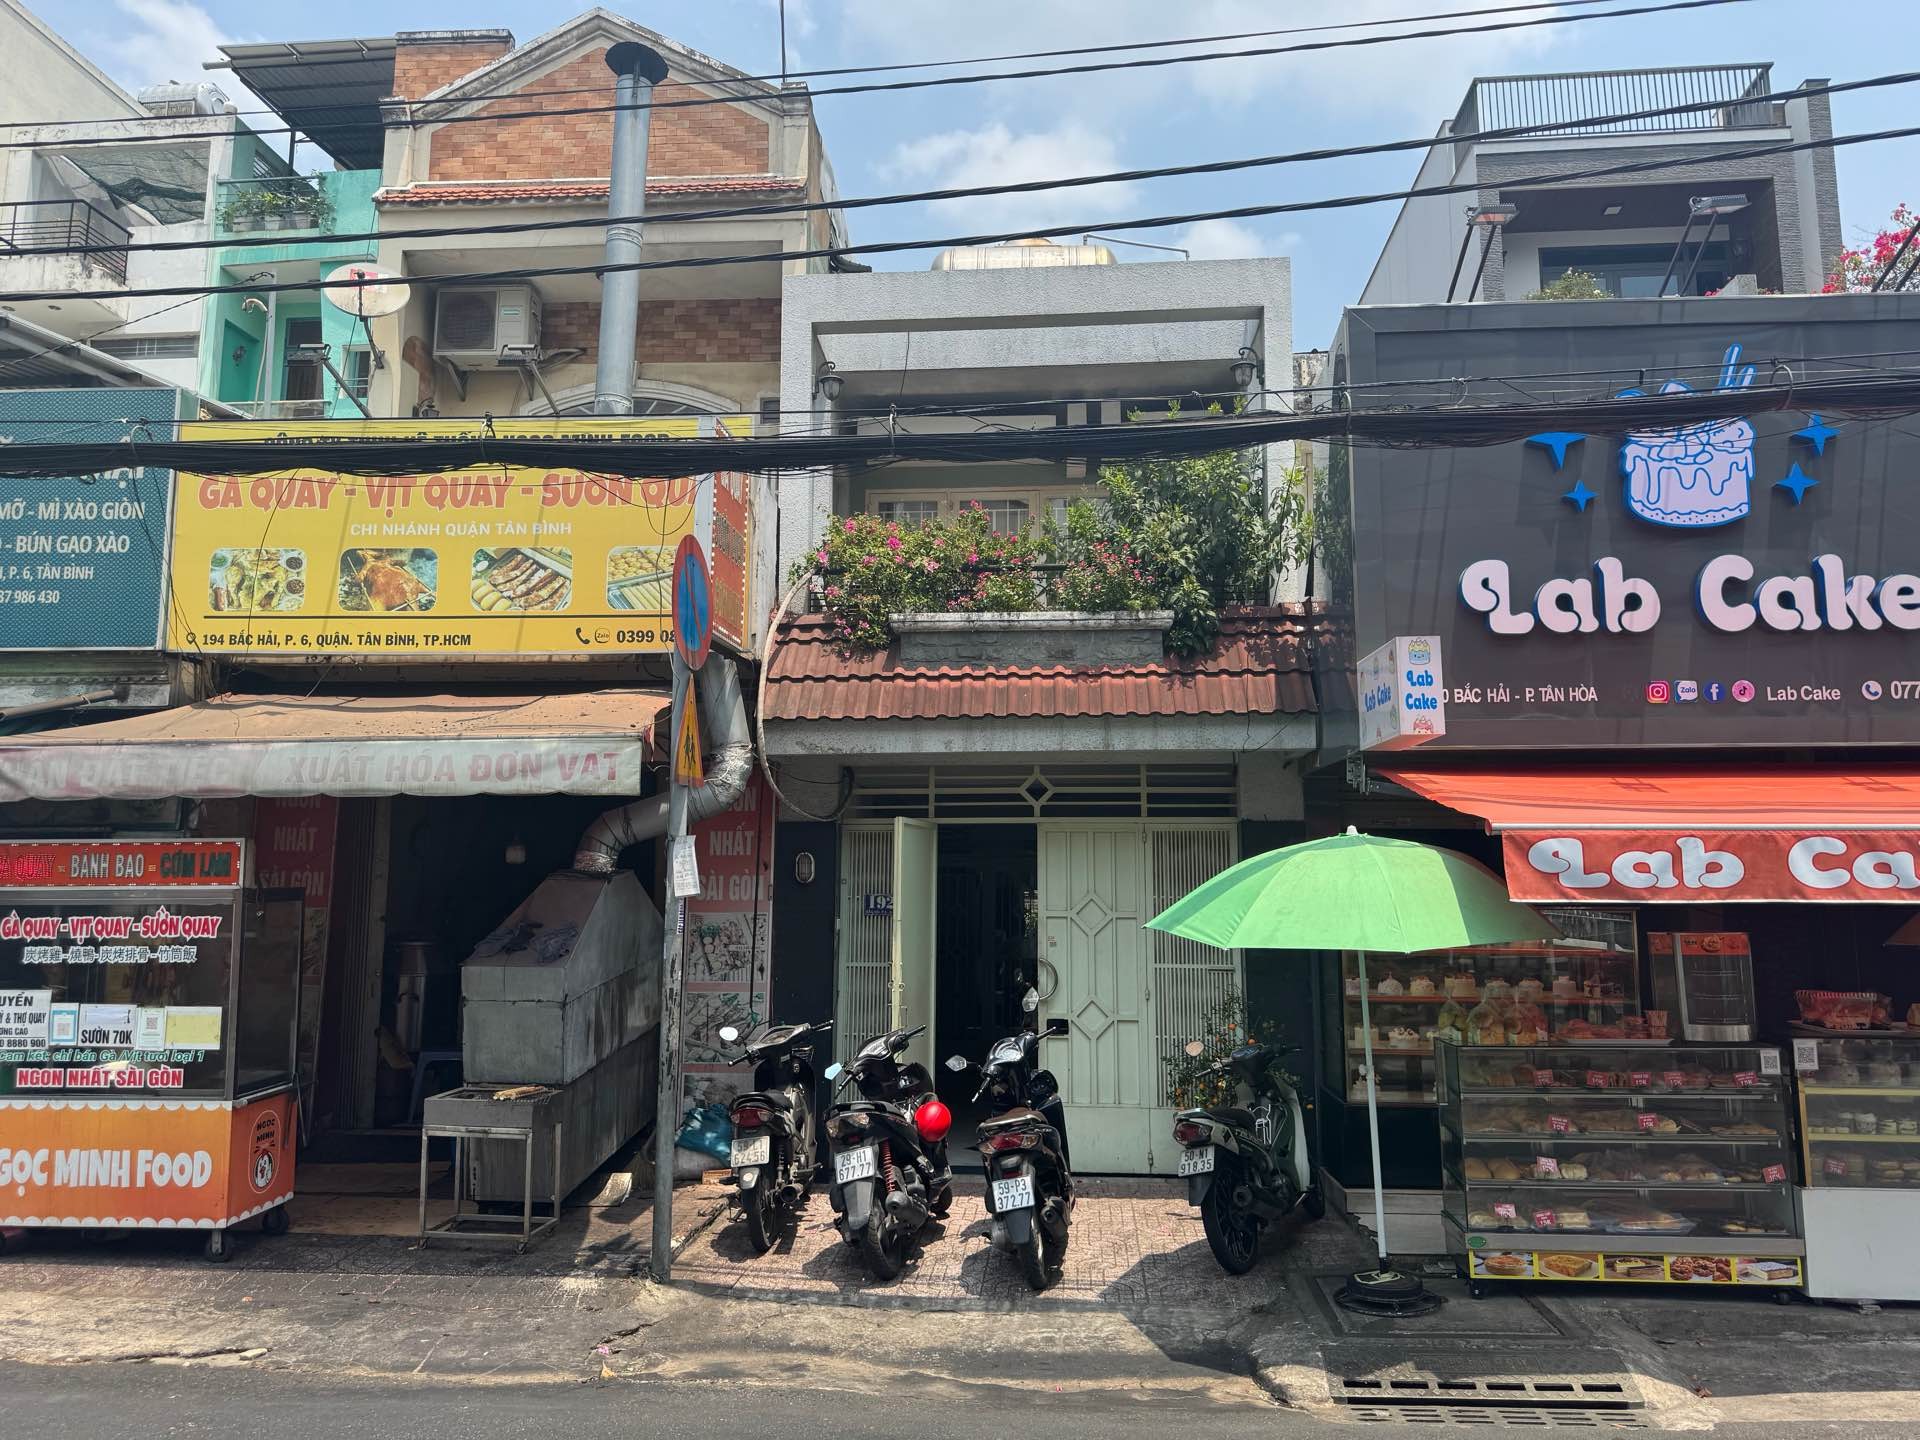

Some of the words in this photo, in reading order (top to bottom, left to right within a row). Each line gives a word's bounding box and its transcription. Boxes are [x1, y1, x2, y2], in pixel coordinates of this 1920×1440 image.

[250, 476, 338, 512] QUAY
[365, 475, 418, 518] VỊT
[423, 474, 514, 511] QUAY
[63, 497, 98, 520] XÀO
[101, 497, 146, 520] GIÒN
[351, 523, 377, 536] CHI
[382, 522, 440, 536] NHÁNH
[446, 522, 490, 538] QUẬN
[496, 521, 527, 536] TÂN
[532, 521, 572, 536] BÌNH
[16, 530, 52, 554] BÚN
[56, 534, 93, 558] GẠO
[95, 530, 131, 554] XÀO
[37, 562, 61, 580] TÂN
[63, 562, 94, 580] BÌNH
[14, 590, 35, 604] 986
[38, 590, 60, 604] 430
[1458, 555, 1662, 635] Lab
[1694, 553, 1920, 633] Cake
[202, 633, 225, 646] 194
[228, 629, 254, 646] BẮC
[257, 630, 281, 648] HẢI,
[284, 634, 296, 646] P.
[300, 634, 312, 648] 6,
[316, 631, 353, 648] QUẬN.
[357, 631, 382, 646] TÂN
[385, 631, 419, 648] BÌNH,
[423, 633, 472, 647] TP.HCM
[616, 630, 655, 644] 0399
[1405, 669, 1434, 687] Lab
[1405, 692, 1438, 710] Cake
[1453, 683, 1482, 703] BẮC
[1486, 683, 1510, 703] HẢI
[1525, 687, 1535, 702] P.
[1539, 685, 1564, 702] TÂN
[1569, 684, 1599, 702] HÒA
[1680, 686, 1697, 694] Zalo
[1767, 686, 1798, 701] Lab
[1800, 685, 1842, 701] Cake
[557, 752, 622, 782] VAT
[708, 821, 755, 857] NHẤT
[70, 848, 110, 878] BÁNH
[115, 853, 146, 878] BAO
[1527, 836, 1746, 889] Lab
[1787, 836, 1920, 889] Ca
[1, 908, 22, 940] GÀ
[22, 917, 62, 943] QUAY
[68, 916, 94, 945] VỊT
[94, 916, 134, 942] QUAY
[141, 905, 181, 939] SƯỜN
[181, 916, 222, 942] QUAY
[80, 1026, 110, 1045] SƯỜN
[113, 1029, 133, 1045] 70K
[74, 1048, 97, 1063] bán
[100, 1049, 118, 1063] Gà
[16, 1067, 64, 1089] NGON
[114, 1063, 145, 1089] SÀI
[147, 1062, 185, 1089] GÒN
[841, 1149, 868, 1167] 29-H1
[54, 1148, 131, 1188] MINH
[136, 1149, 213, 1188] FOOD
[838, 1161, 872, 1182] 677.77
[998, 1178, 1028, 1196] 59-P3
[997, 1191, 1031, 1210] 372.77
